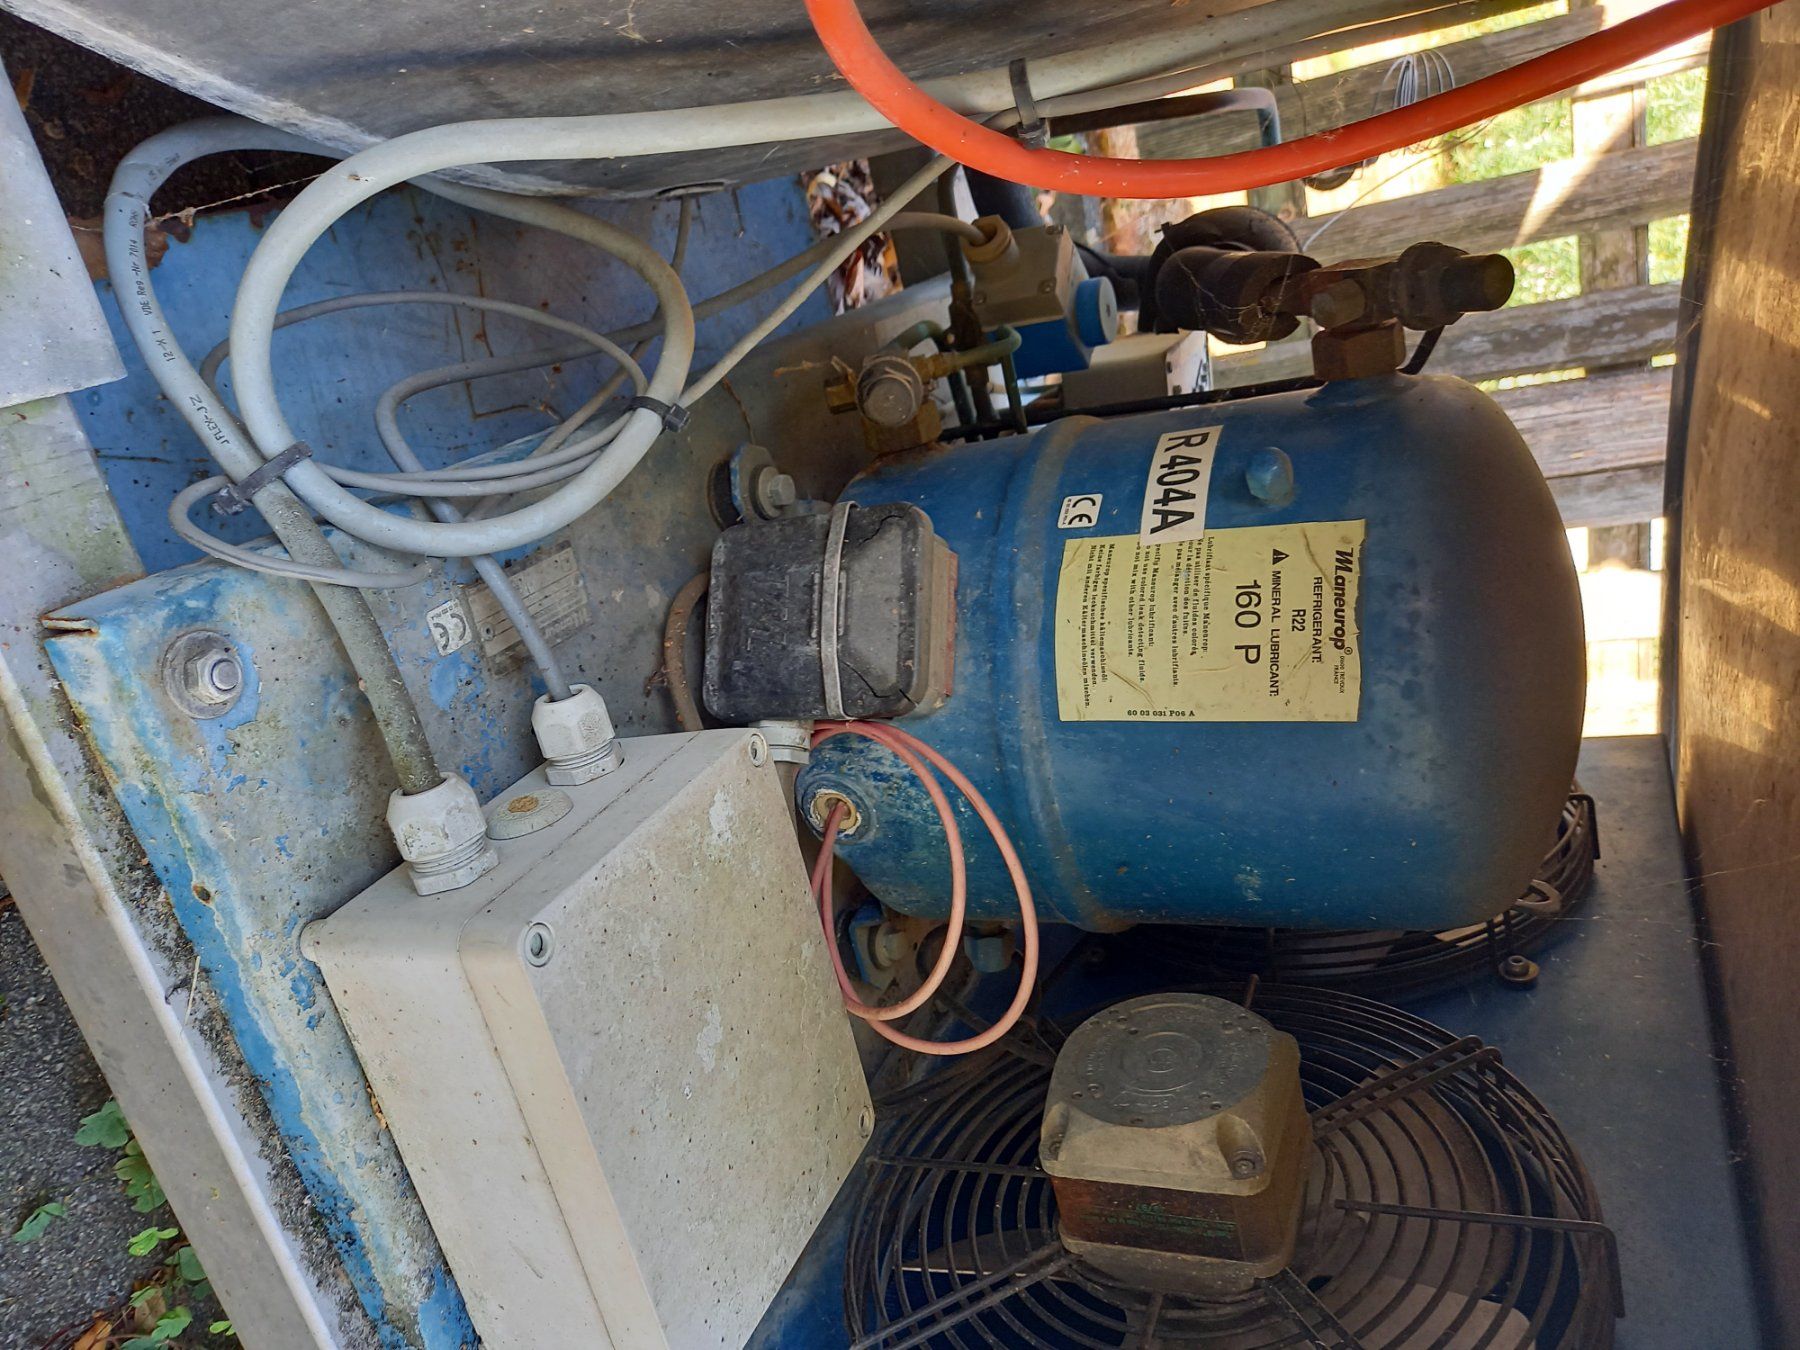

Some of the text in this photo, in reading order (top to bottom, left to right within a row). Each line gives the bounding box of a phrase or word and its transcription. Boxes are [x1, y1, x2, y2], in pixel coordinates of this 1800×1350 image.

[140, 299, 153, 316] VDE
[1149, 432, 1210, 535] R404A
[1088, 545, 1096, 562] Nicht
[1097, 544, 1106, 562] Keine
[1104, 544, 1115, 576] Maneurop
[1186, 554, 1193, 562] la
[1082, 576, 1090, 602] anderen
[1092, 564, 1102, 592] farbigen
[1148, 568, 1159, 602] Maneurop
[1172, 562, 1182, 594] mélanger
[1184, 563, 1192, 595] détection
[1193, 588, 1200, 597] de
[1234, 579, 1262, 664] 160 P
[1269, 570, 1282, 697] MINERAL LUBRICANT:
[1292, 609, 1306, 632] R22
[1312, 576, 1322, 663] REFRIGERANT:
[1137, 622, 1145, 658] detecting
